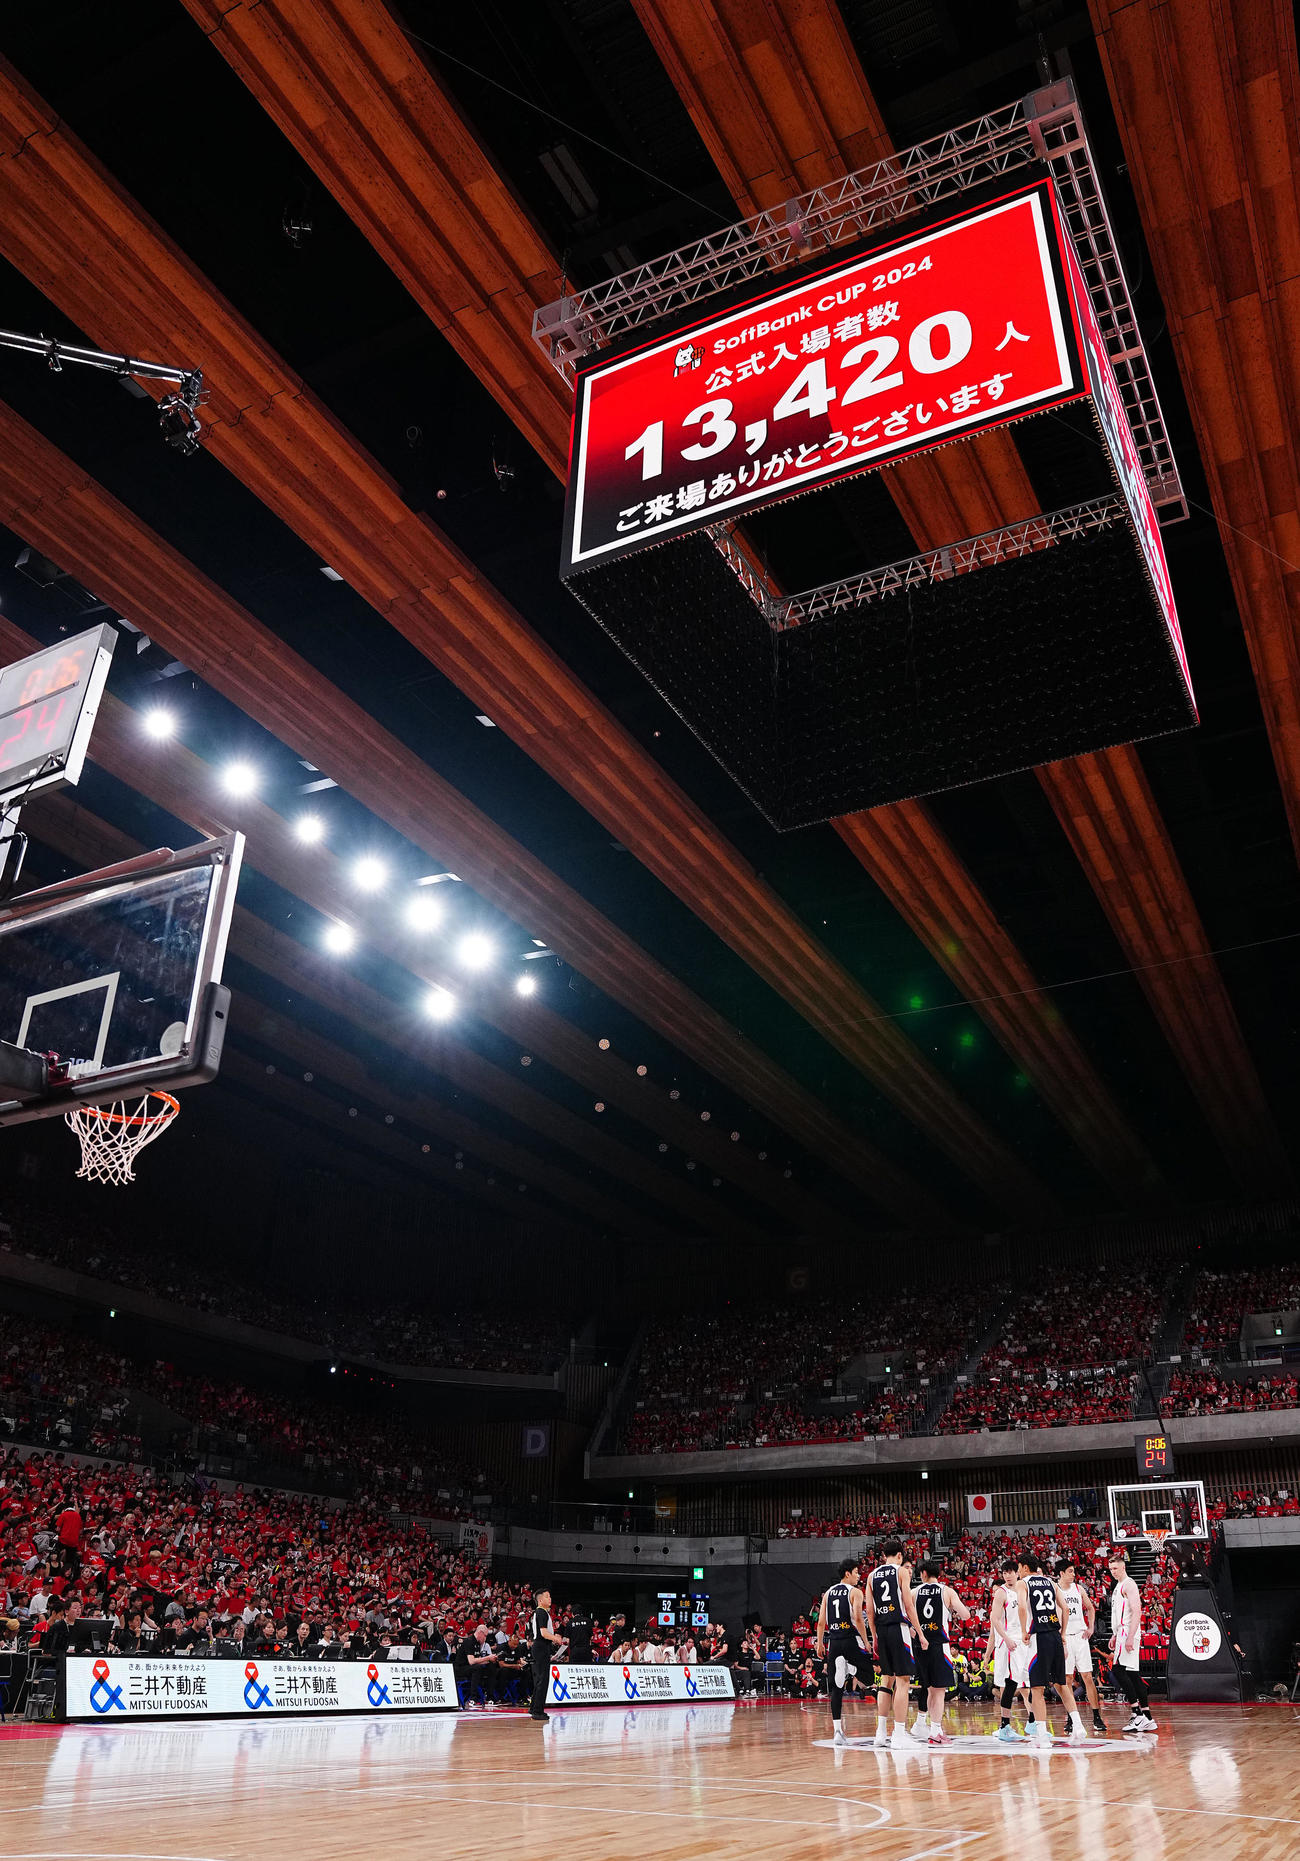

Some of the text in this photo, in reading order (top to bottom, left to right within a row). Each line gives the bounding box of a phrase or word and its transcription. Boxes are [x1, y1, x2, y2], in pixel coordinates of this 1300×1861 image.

[713, 255, 934, 355] SoftBank CUP 2024
[704, 300, 901, 394] 公式入場者数
[623, 310, 1031, 483] 13,420 人
[615, 371, 1014, 533] ご来場ありがとうございます
[526, 1429, 546, 1454] D
[1145, 1437, 1167, 1450] 0:06
[1145, 1451, 1167, 1468] 24
[880, 1580, 892, 1602] 2
[1033, 1589, 1055, 1611] 23
[662, 1600, 671, 1611] 52
[695, 1601, 705, 1612] 72
[832, 1599, 840, 1619] 1
[923, 1598, 934, 1619] 6
[1037, 1615, 1049, 1624] KB
[129, 1675, 207, 1696] 三井不動産
[274, 1675, 338, 1694] 三井不動産
[392, 1676, 444, 1692] 三井不動産
[569, 1675, 607, 1690] 三井不動産
[638, 1675, 671, 1689] 三井不動産
[129, 1699, 208, 1710] MITSUI FUDOSAN
[275, 1697, 339, 1707] MITSUI FUDOSAN
[393, 1695, 446, 1704] MITSUI FUDOSAN
